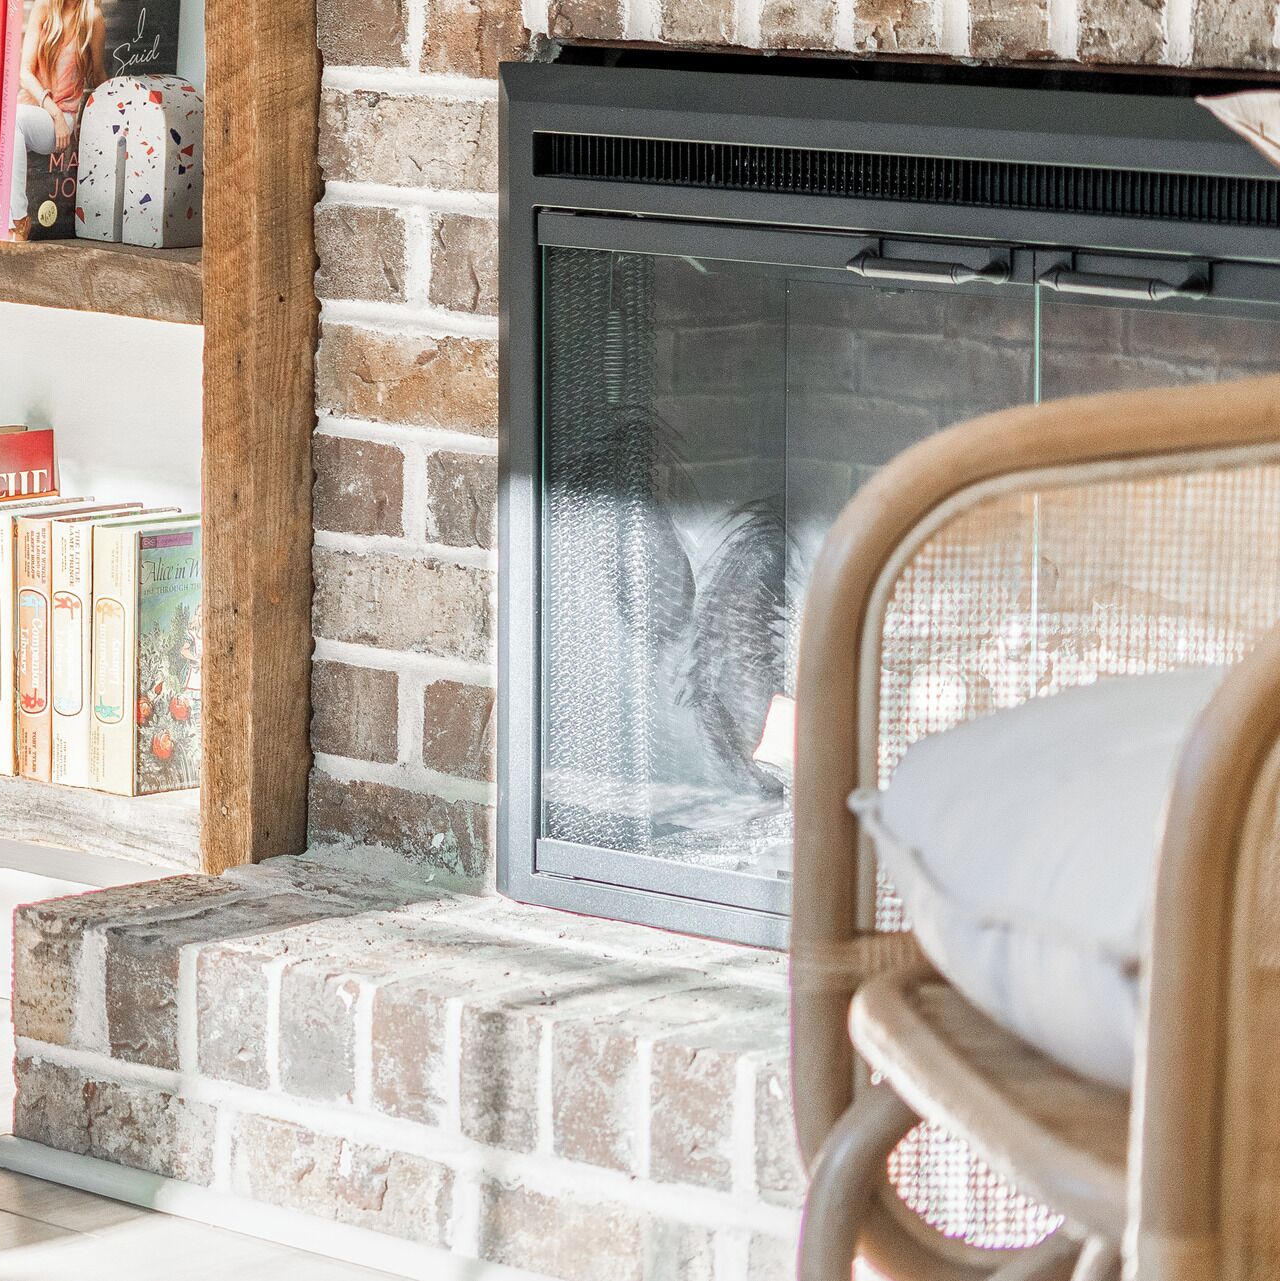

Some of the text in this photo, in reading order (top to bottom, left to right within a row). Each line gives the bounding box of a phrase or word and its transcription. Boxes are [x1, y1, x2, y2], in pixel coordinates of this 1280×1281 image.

[112, 34, 160, 76] Said
[140, 556, 186, 586] Alice in
[19, 626, 29, 674] Library
[30, 617, 42, 690] Companion
